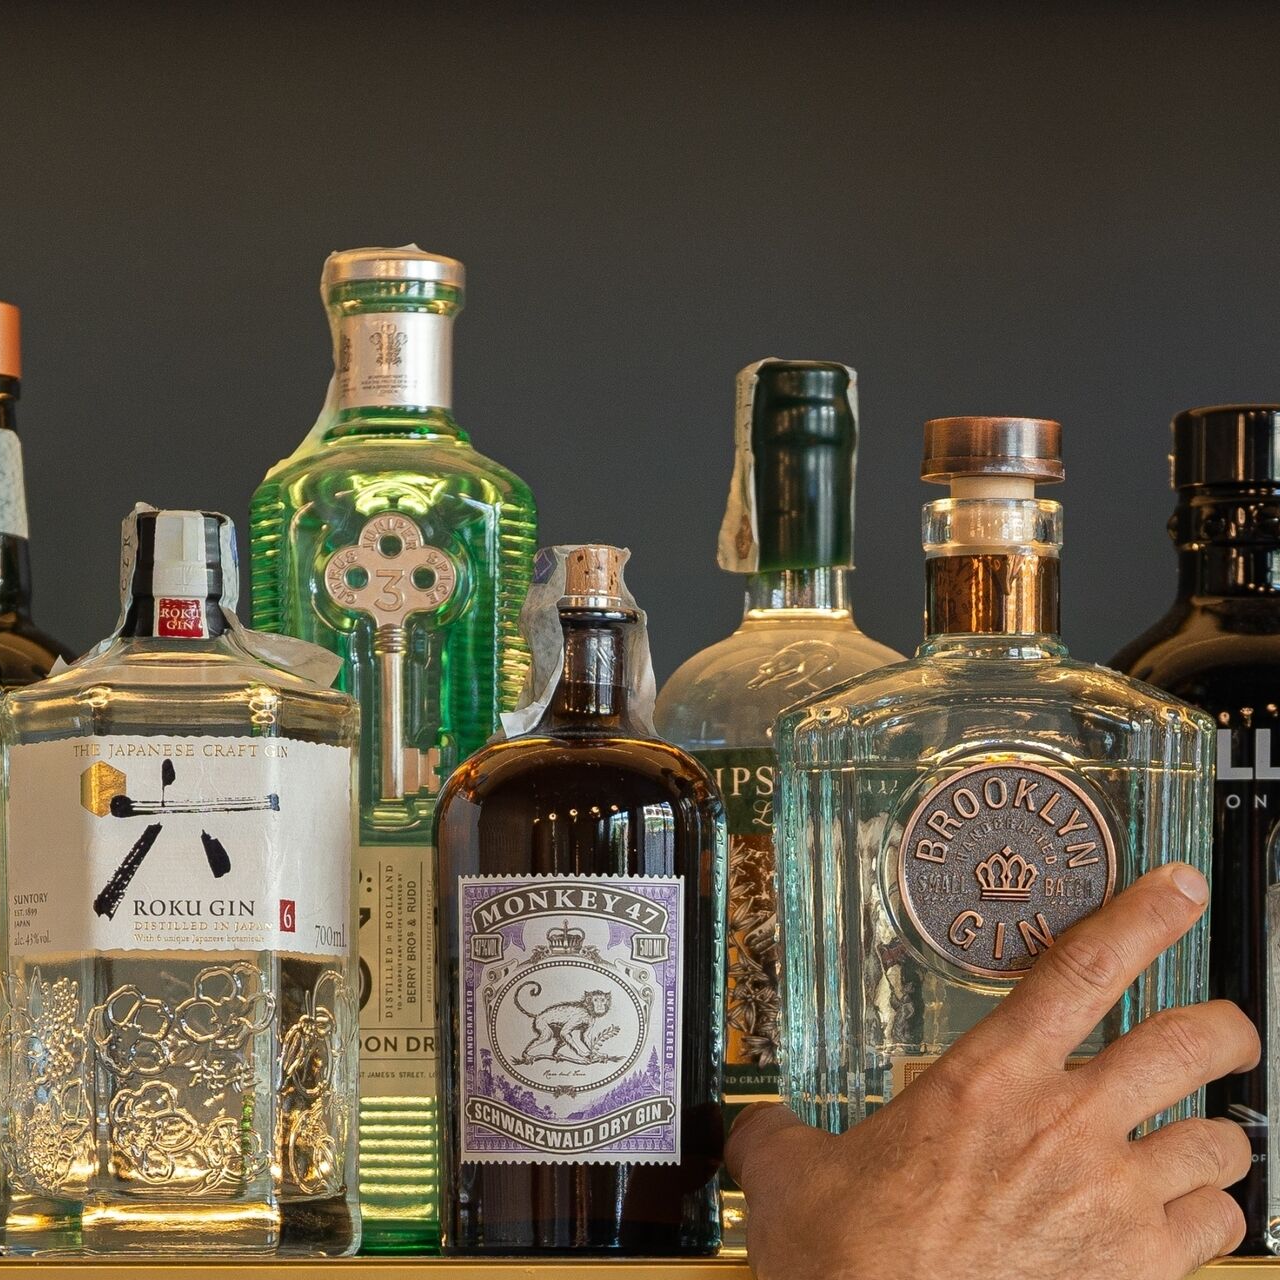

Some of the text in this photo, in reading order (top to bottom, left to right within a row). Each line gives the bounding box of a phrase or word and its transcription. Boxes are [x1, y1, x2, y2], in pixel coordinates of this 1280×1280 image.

[363, 518, 417, 552] JUNIPER
[373, 569, 404, 612] 3
[166, 620, 194, 630] GIN
[73, 743, 289, 759] THE JAPANESE CRAFT GIN
[915, 776, 1099, 869] BROOKLYN
[13, 893, 49, 905] SUNTORY
[1044, 876, 1094, 898] BATCH
[133, 899, 255, 917] ROKU GIN
[133, 921, 273, 932] DISTILLED IN JAPAN
[478, 888, 661, 928] MONKEY 47
[384, 864, 394, 1018] DISTILLED HOLLAND
[406, 879, 417, 1004] BERRY RUDD
[948, 909, 1057, 960] GIN
[667, 990, 675, 1060] UNFILTERED
[474, 1101, 662, 1149] SCHWARZWALD DRY GIN
